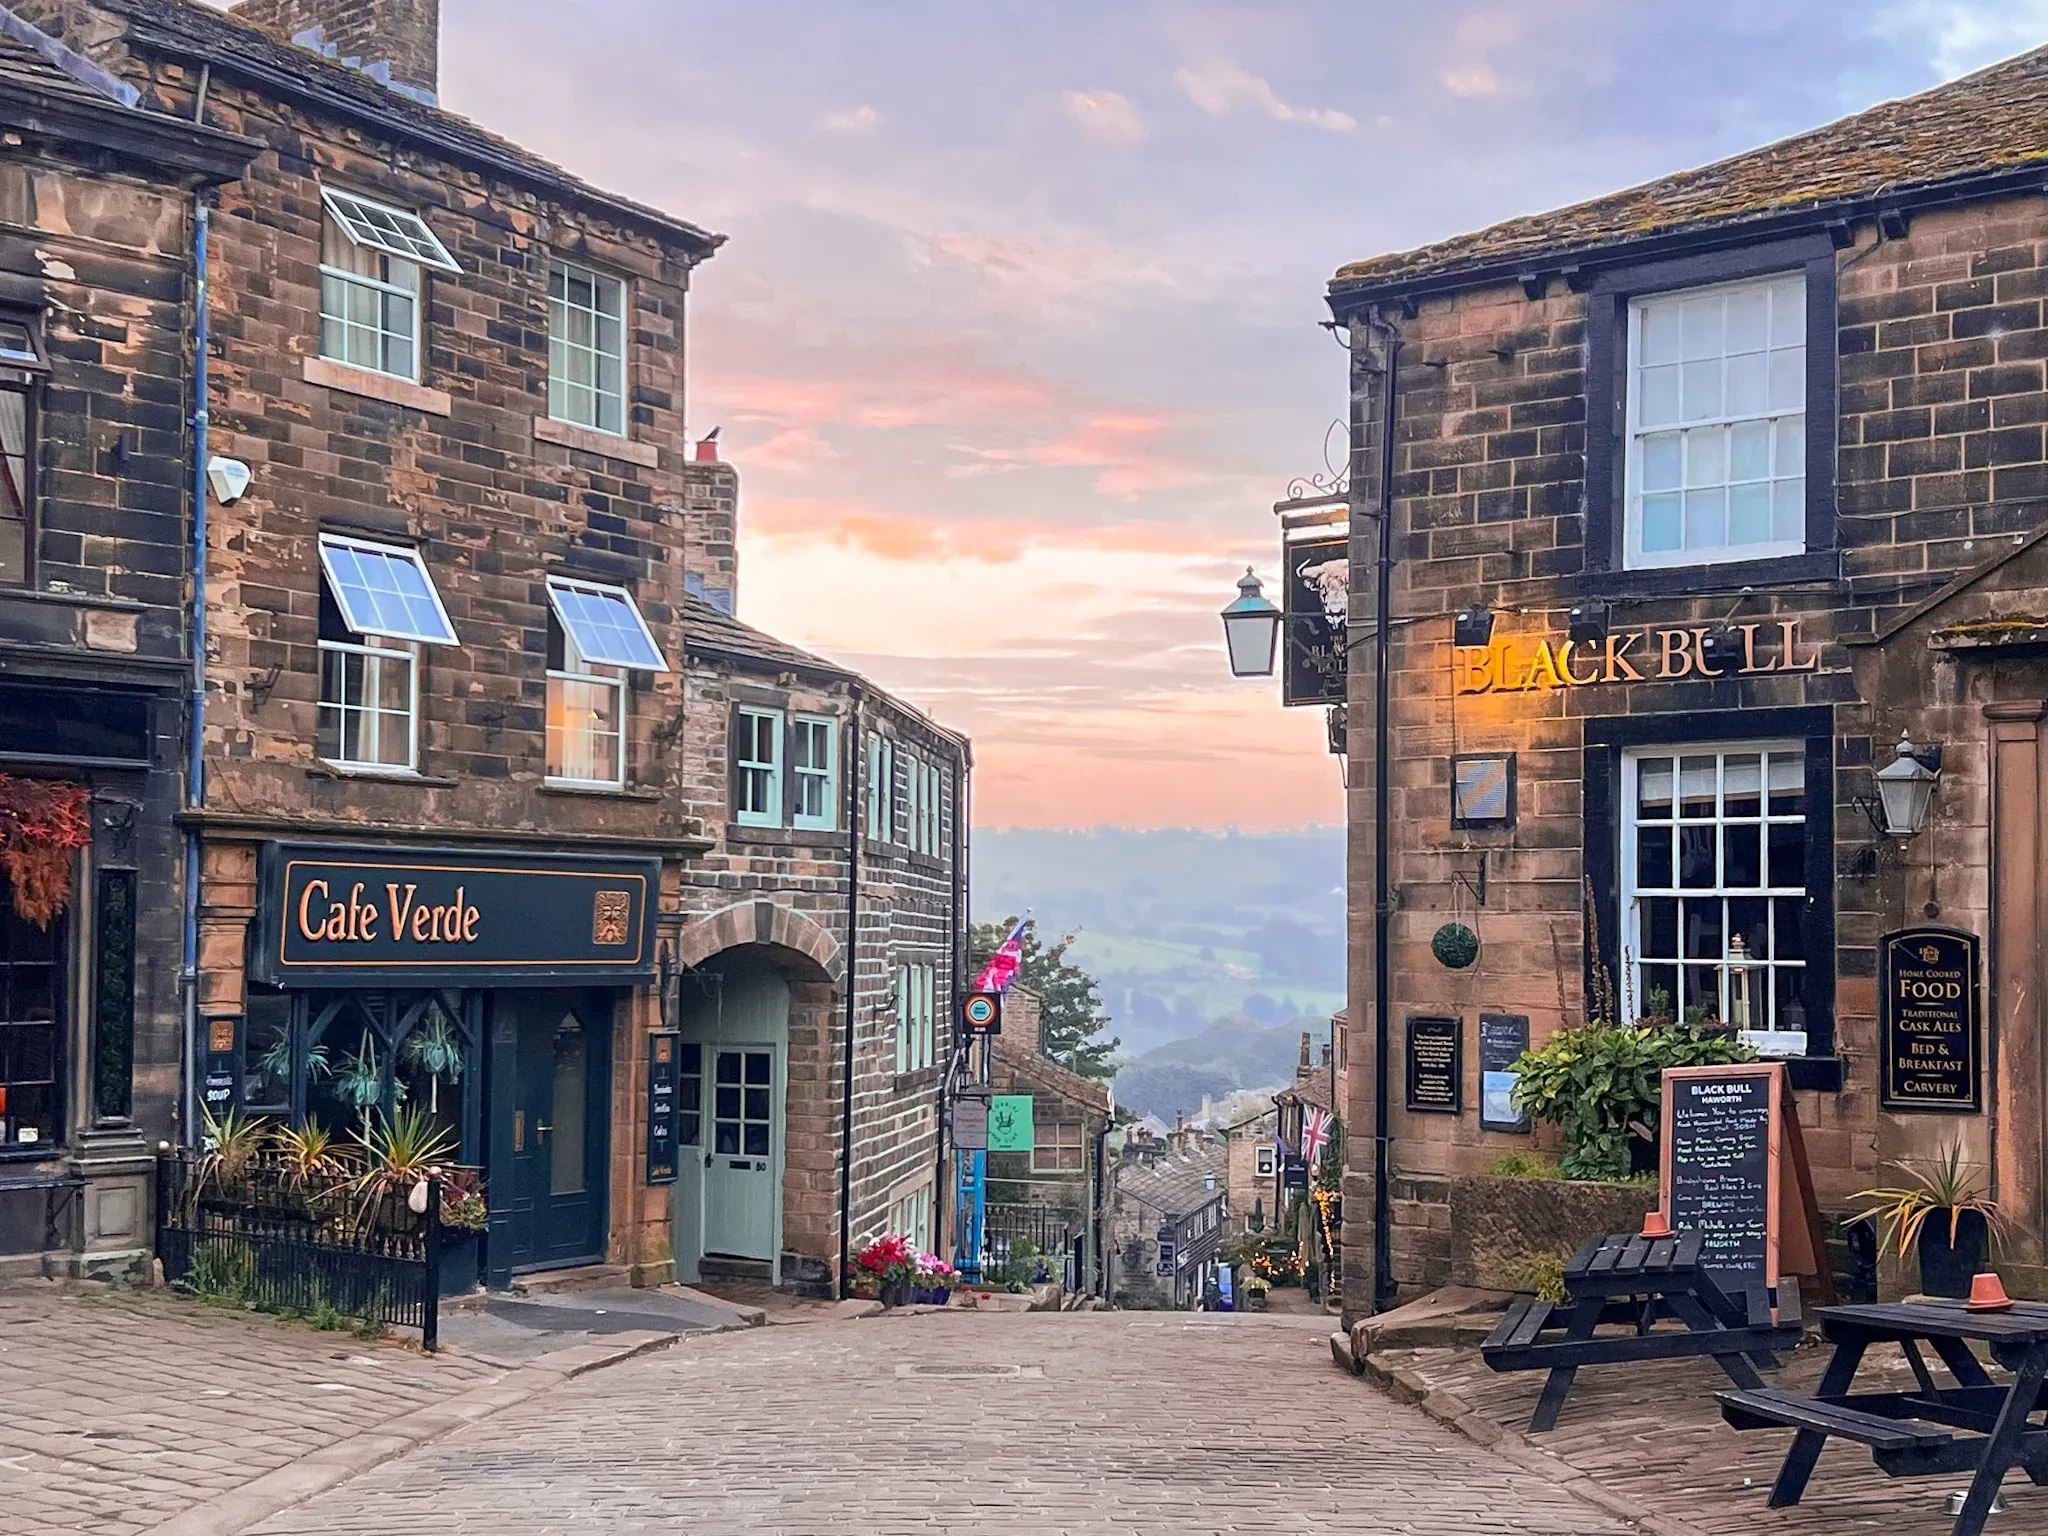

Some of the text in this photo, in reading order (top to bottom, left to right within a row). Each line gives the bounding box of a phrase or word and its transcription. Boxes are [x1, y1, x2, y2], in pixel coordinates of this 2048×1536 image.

[1458, 632, 1646, 694] BLACK
[299, 880, 481, 942] Cafe Verde
[1899, 969, 1961, 979] HOME COOKED
[1900, 979, 1961, 999] FOOD
[1901, 1008, 1959, 1020] TRADITIONAL
[1899, 1020, 1962, 1033] CASK ALES
[1911, 1042, 1950, 1056] BED &
[1899, 1057, 1963, 1072] BREAKFAST
[1691, 1083, 1752, 1096] BLACK BULL
[1903, 1080, 1958, 1095] CARVERY
[207, 1088, 231, 1102] SOUP
[1701, 1095, 1743, 1104] HAWORTH
